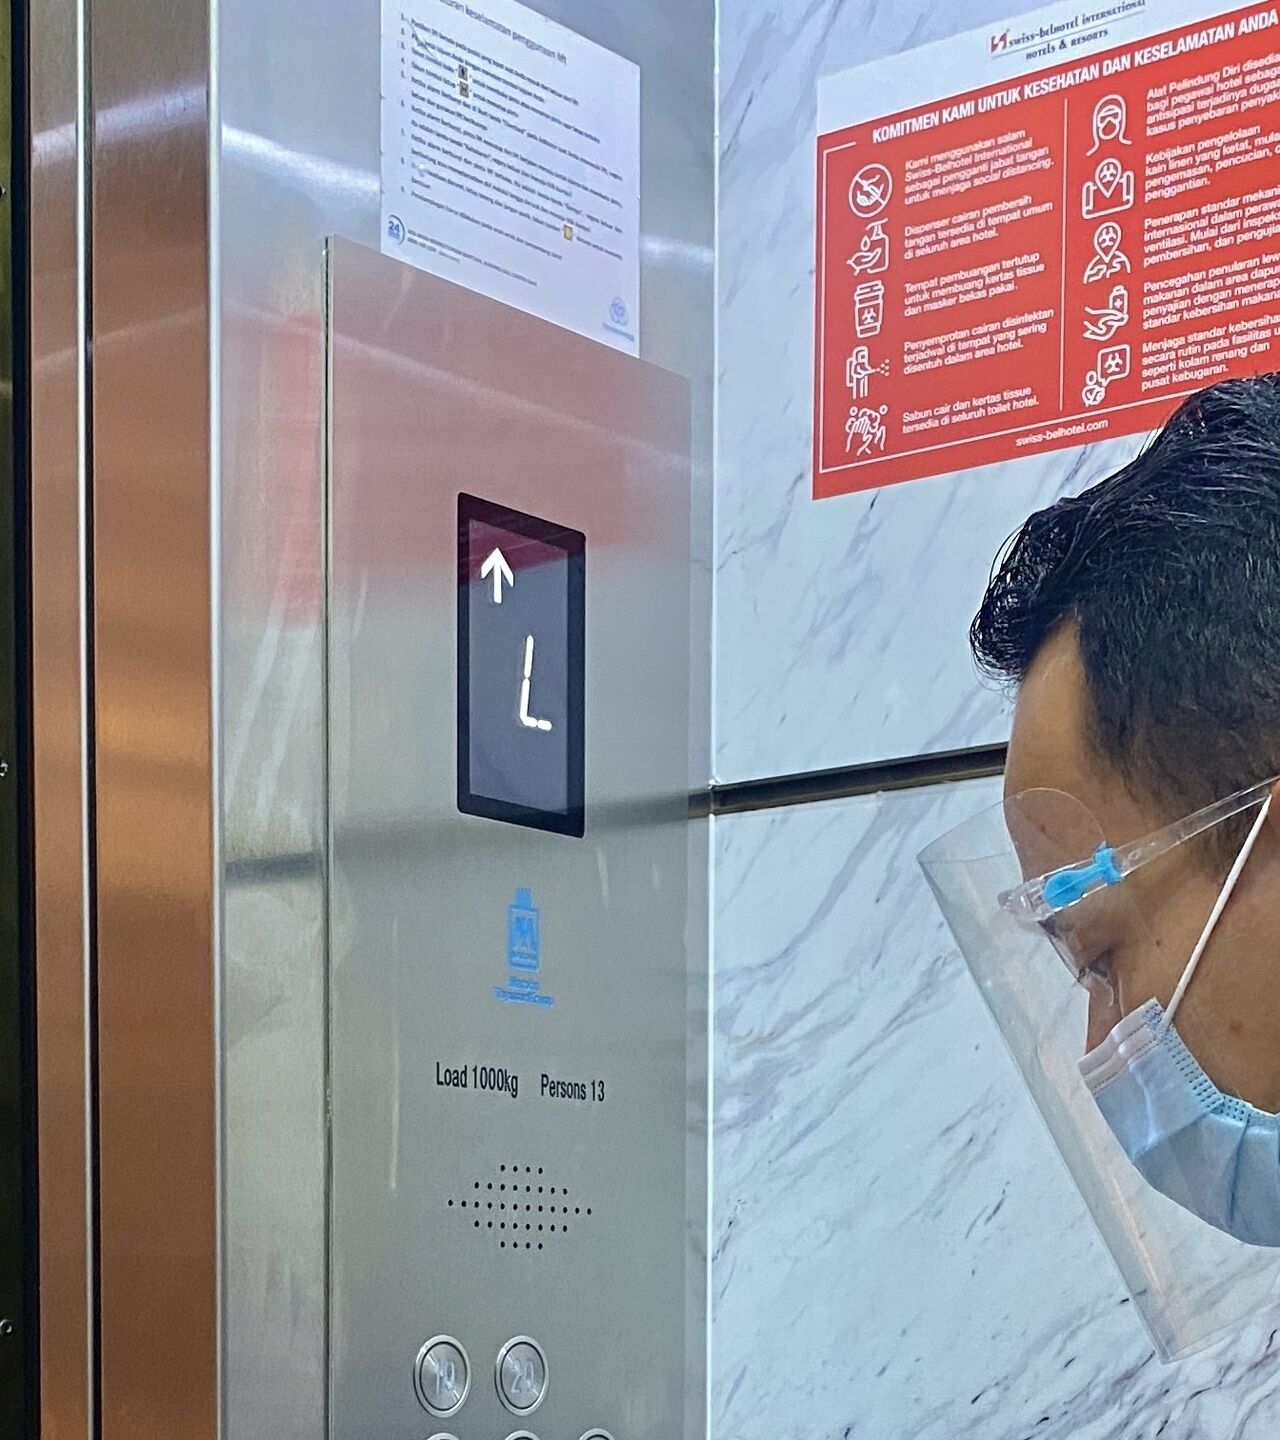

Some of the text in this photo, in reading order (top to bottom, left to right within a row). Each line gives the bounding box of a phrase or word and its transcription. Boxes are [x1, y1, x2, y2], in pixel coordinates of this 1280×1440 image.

[1059, 40, 1066, 50] &
[1071, 29, 1108, 47] RESORTS
[873, 9, 1279, 143] KOMITMEN KAMI UNTUK KESEHATAN DAN KESELAMATAN ANDA
[1147, 86, 1166, 100] Alat
[1169, 72, 1220, 93] Pelindung
[1223, 64, 1240, 78] Diri
[1147, 97, 1169, 111] bagi
[1171, 84, 1214, 107] pegawai
[1216, 76, 1242, 92] hotel
[1147, 102, 1194, 124] antisipasi
[1197, 89, 1247, 110] terjadinya
[1147, 121, 1176, 135] kasus
[1178, 104, 1238, 130] penyebaran
[905, 138, 1033, 181] Swiss-Belhotel International
[906, 131, 1025, 170] Kami menggunakan salam
[905, 148, 1049, 193] sebagai pengganti jabat tangan
[905, 158, 1054, 204] untuk menjaga social distancing.
[1144, 209, 1198, 229] Penerapan
[1201, 198, 1240, 214] standar
[1144, 216, 1208, 241] internasional
[1211, 210, 1242, 224] dalam
[1144, 234, 1188, 253] ventilasi.
[1190, 226, 1218, 241] Mulai
[1220, 220, 1240, 234] dari
[1144, 242, 1212, 267] pembersihan,
[1215, 236, 1234, 247] dan
[905, 254, 1039, 293] Tempat pembuangan tertutup
[905, 264, 1045, 305] untuk membuang kertas tissue
[1144, 271, 1206, 292] Pencegahan
[1209, 259, 1260, 280] penularan
[1144, 287, 1189, 304] makanan
[1192, 279, 1223, 293] dalam
[1225, 273, 1248, 285] area
[905, 281, 1018, 316] dan masker bekas pakai.
[1143, 299, 1191, 318] penyajian
[1193, 290, 1232, 304] dengan
[1143, 314, 1181, 329] standar
[1183, 301, 1239, 320] kebersihan
[905, 310, 1054, 351] Penyemprotan cairan disinfektan
[905, 323, 1047, 362] terjadwal di tempat yang sering
[1142, 351, 1175, 364] secara
[1178, 344, 1201, 357] rutin
[1204, 338, 1230, 354] pada
[1232, 330, 1272, 345] fasilitas
[1143, 337, 1185, 352] Menjaga
[1188, 327, 1227, 342] standar
[904, 339, 1023, 374] disentuh dalam area hotel.
[1142, 343, 1270, 378] seperti kolam renang dan
[1142, 364, 1229, 391] pusat kebugaran.
[902, 396, 1039, 433] tersedia di seluruh toilet hotel.
[903, 388, 1031, 422] Sabun cair dan kertas tissue
[1016, 420, 1108, 446] swiss-belhotel.com
[519, 635, 552, 731] L
[436, 1061, 518, 1098] Load 1000kg
[540, 1074, 605, 1102] Persons 13
